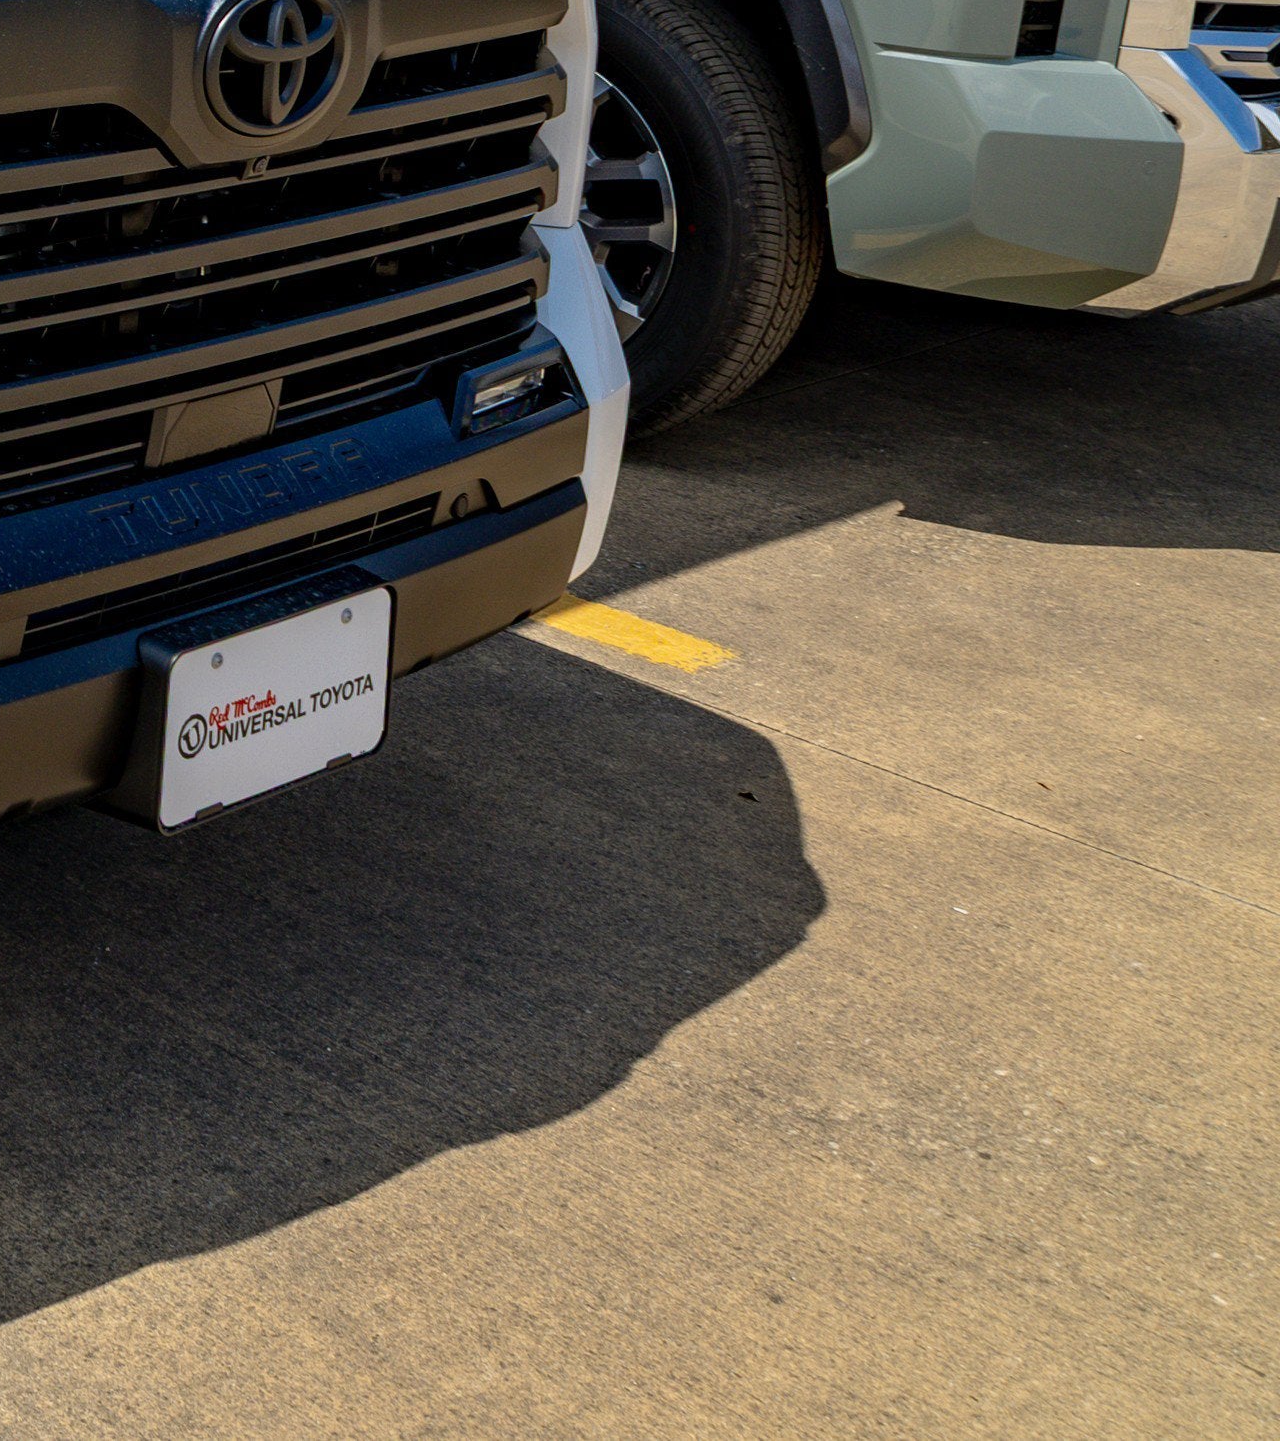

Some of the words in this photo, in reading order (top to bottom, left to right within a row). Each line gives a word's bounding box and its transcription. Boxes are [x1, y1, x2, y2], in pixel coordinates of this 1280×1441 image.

[88, 437, 384, 546] TUNDRA
[208, 699, 307, 749] UNIVERSAL
[310, 674, 374, 712] TOYOTA
[209, 707, 230, 731] Red
